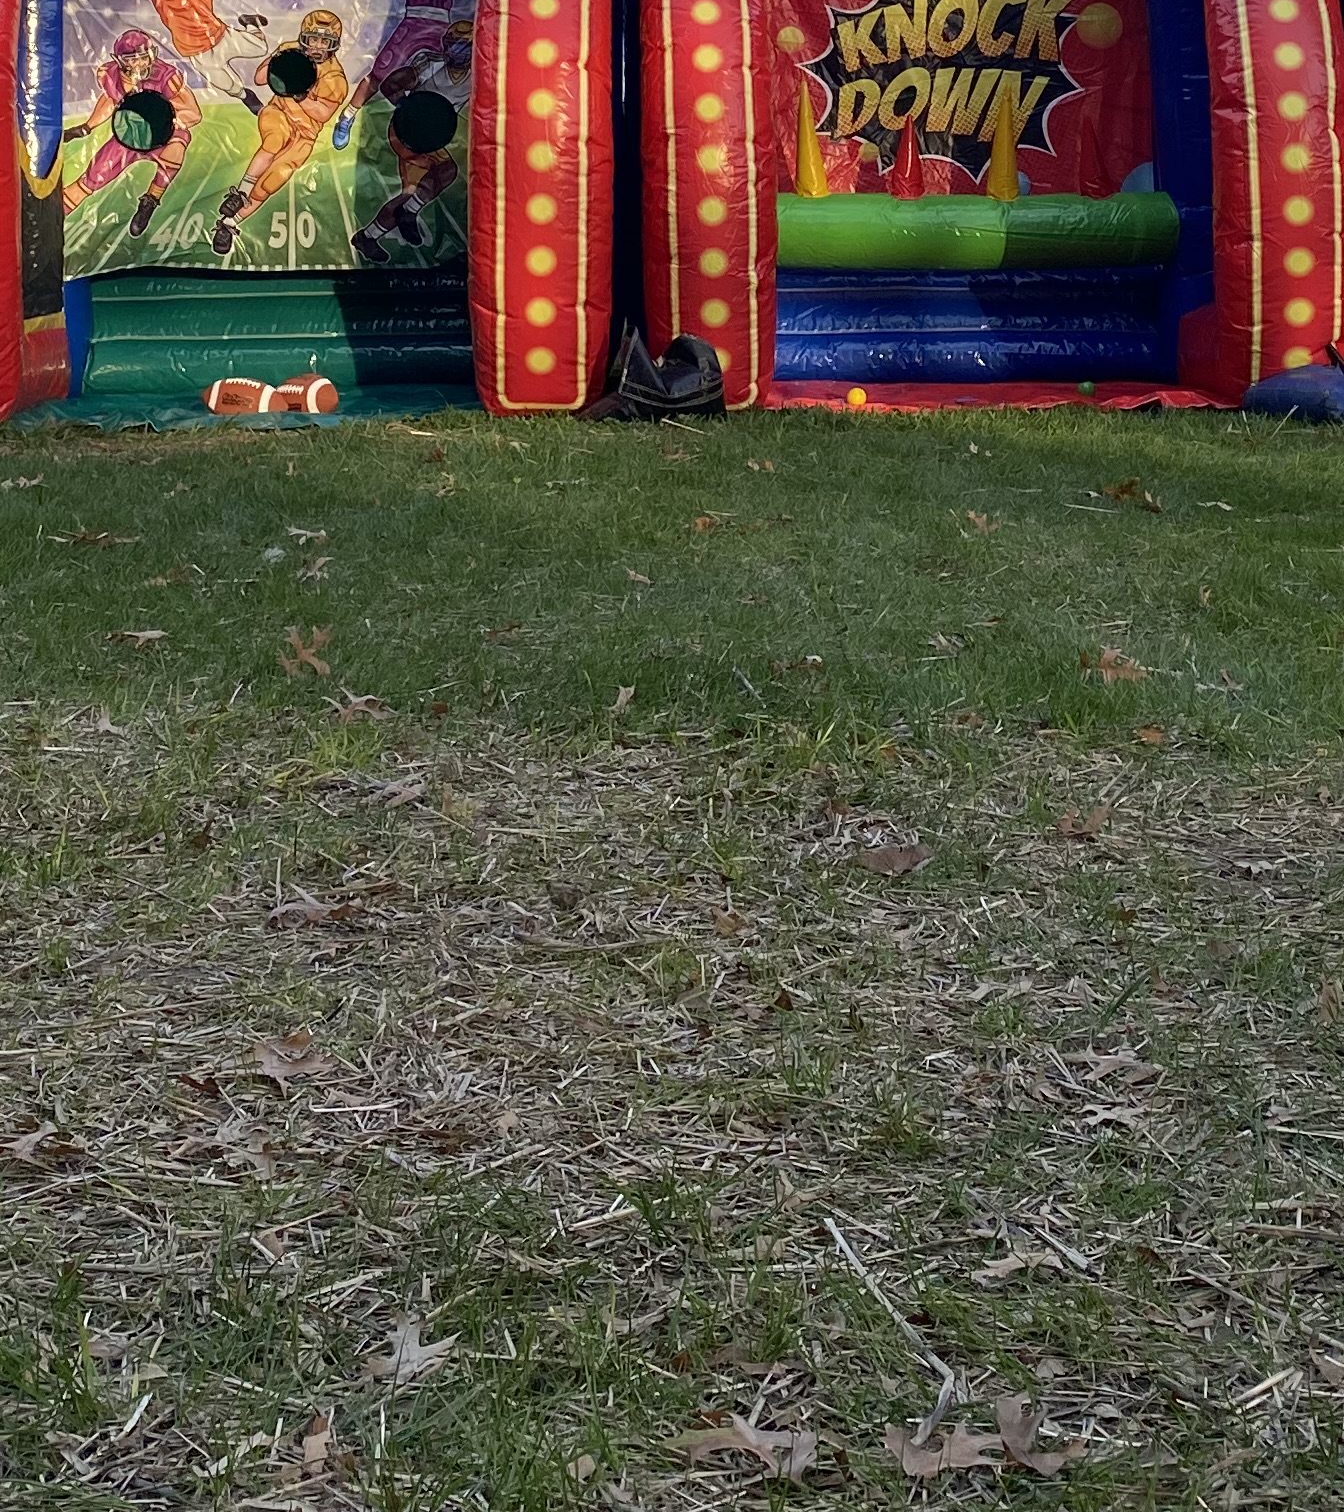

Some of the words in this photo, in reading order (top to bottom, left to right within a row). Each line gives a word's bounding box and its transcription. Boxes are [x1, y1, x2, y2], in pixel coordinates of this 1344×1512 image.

[834, 66, 1051, 143] DOWN
[148, 212, 205, 254] 40
[267, 211, 317, 249] 50
